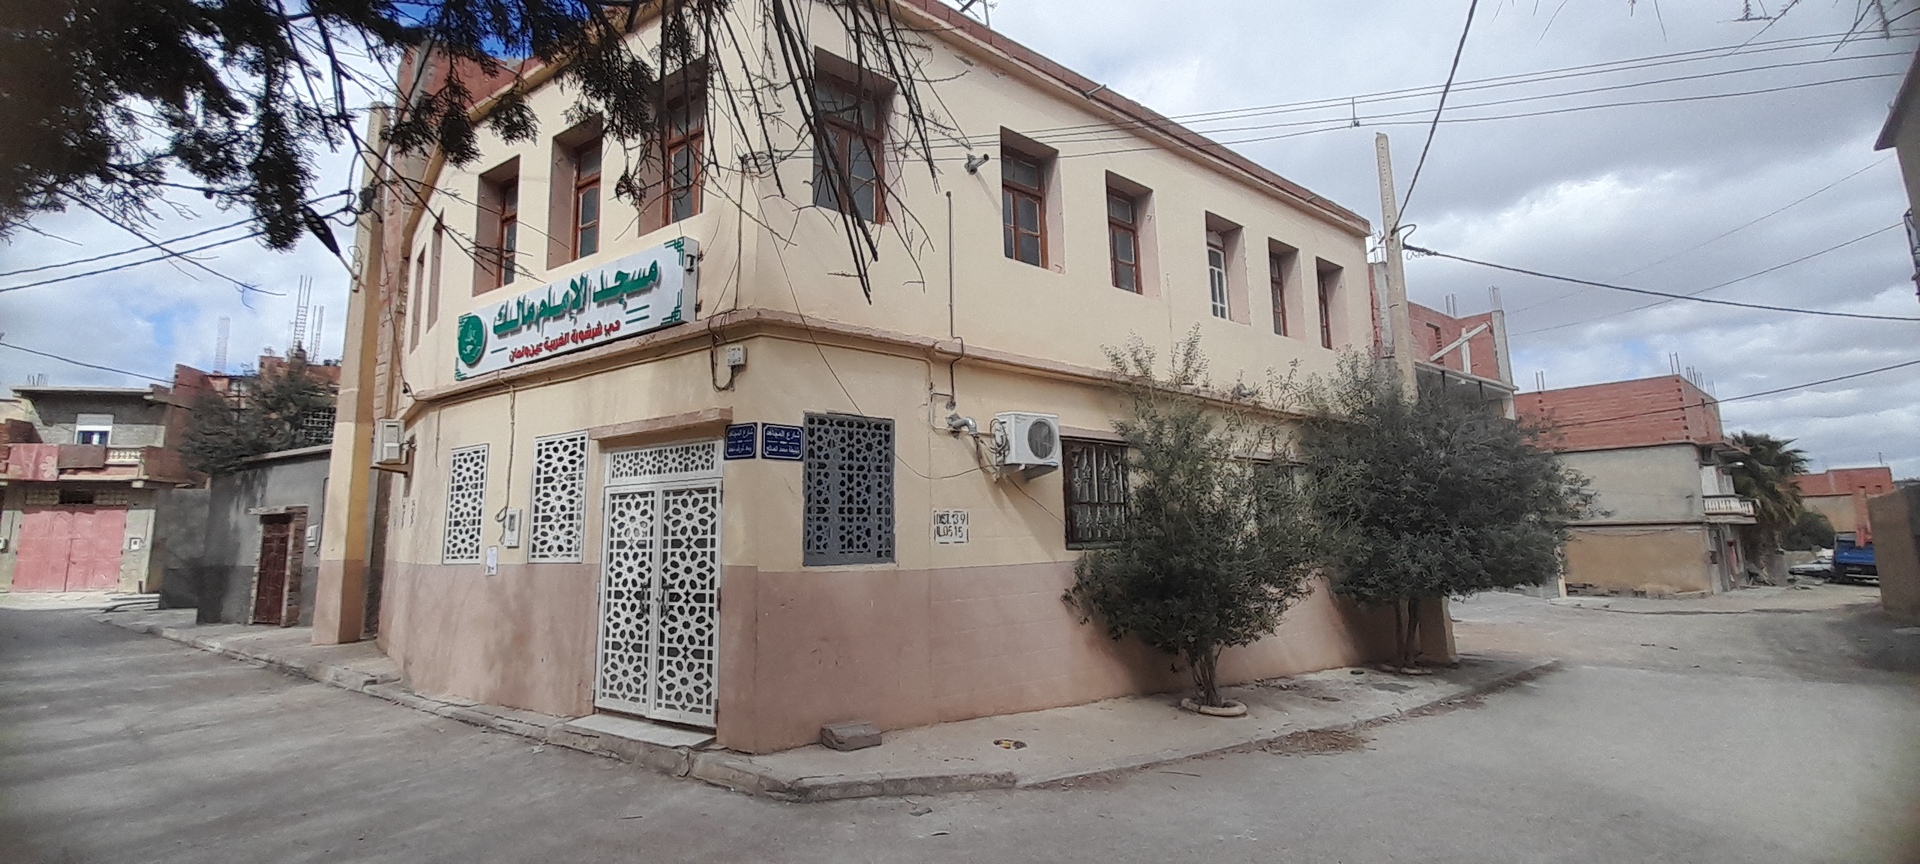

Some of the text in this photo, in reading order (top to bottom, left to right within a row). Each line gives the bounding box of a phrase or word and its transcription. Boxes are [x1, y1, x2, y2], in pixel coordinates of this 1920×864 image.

[493, 259, 659, 335] مسجد الإمام مالك
[604, 319, 621, 337] حي
[544, 332, 570, 352] الغربية
[742, 428, 753, 439] شارع
[766, 429, 800, 441] شارع المجاهد
